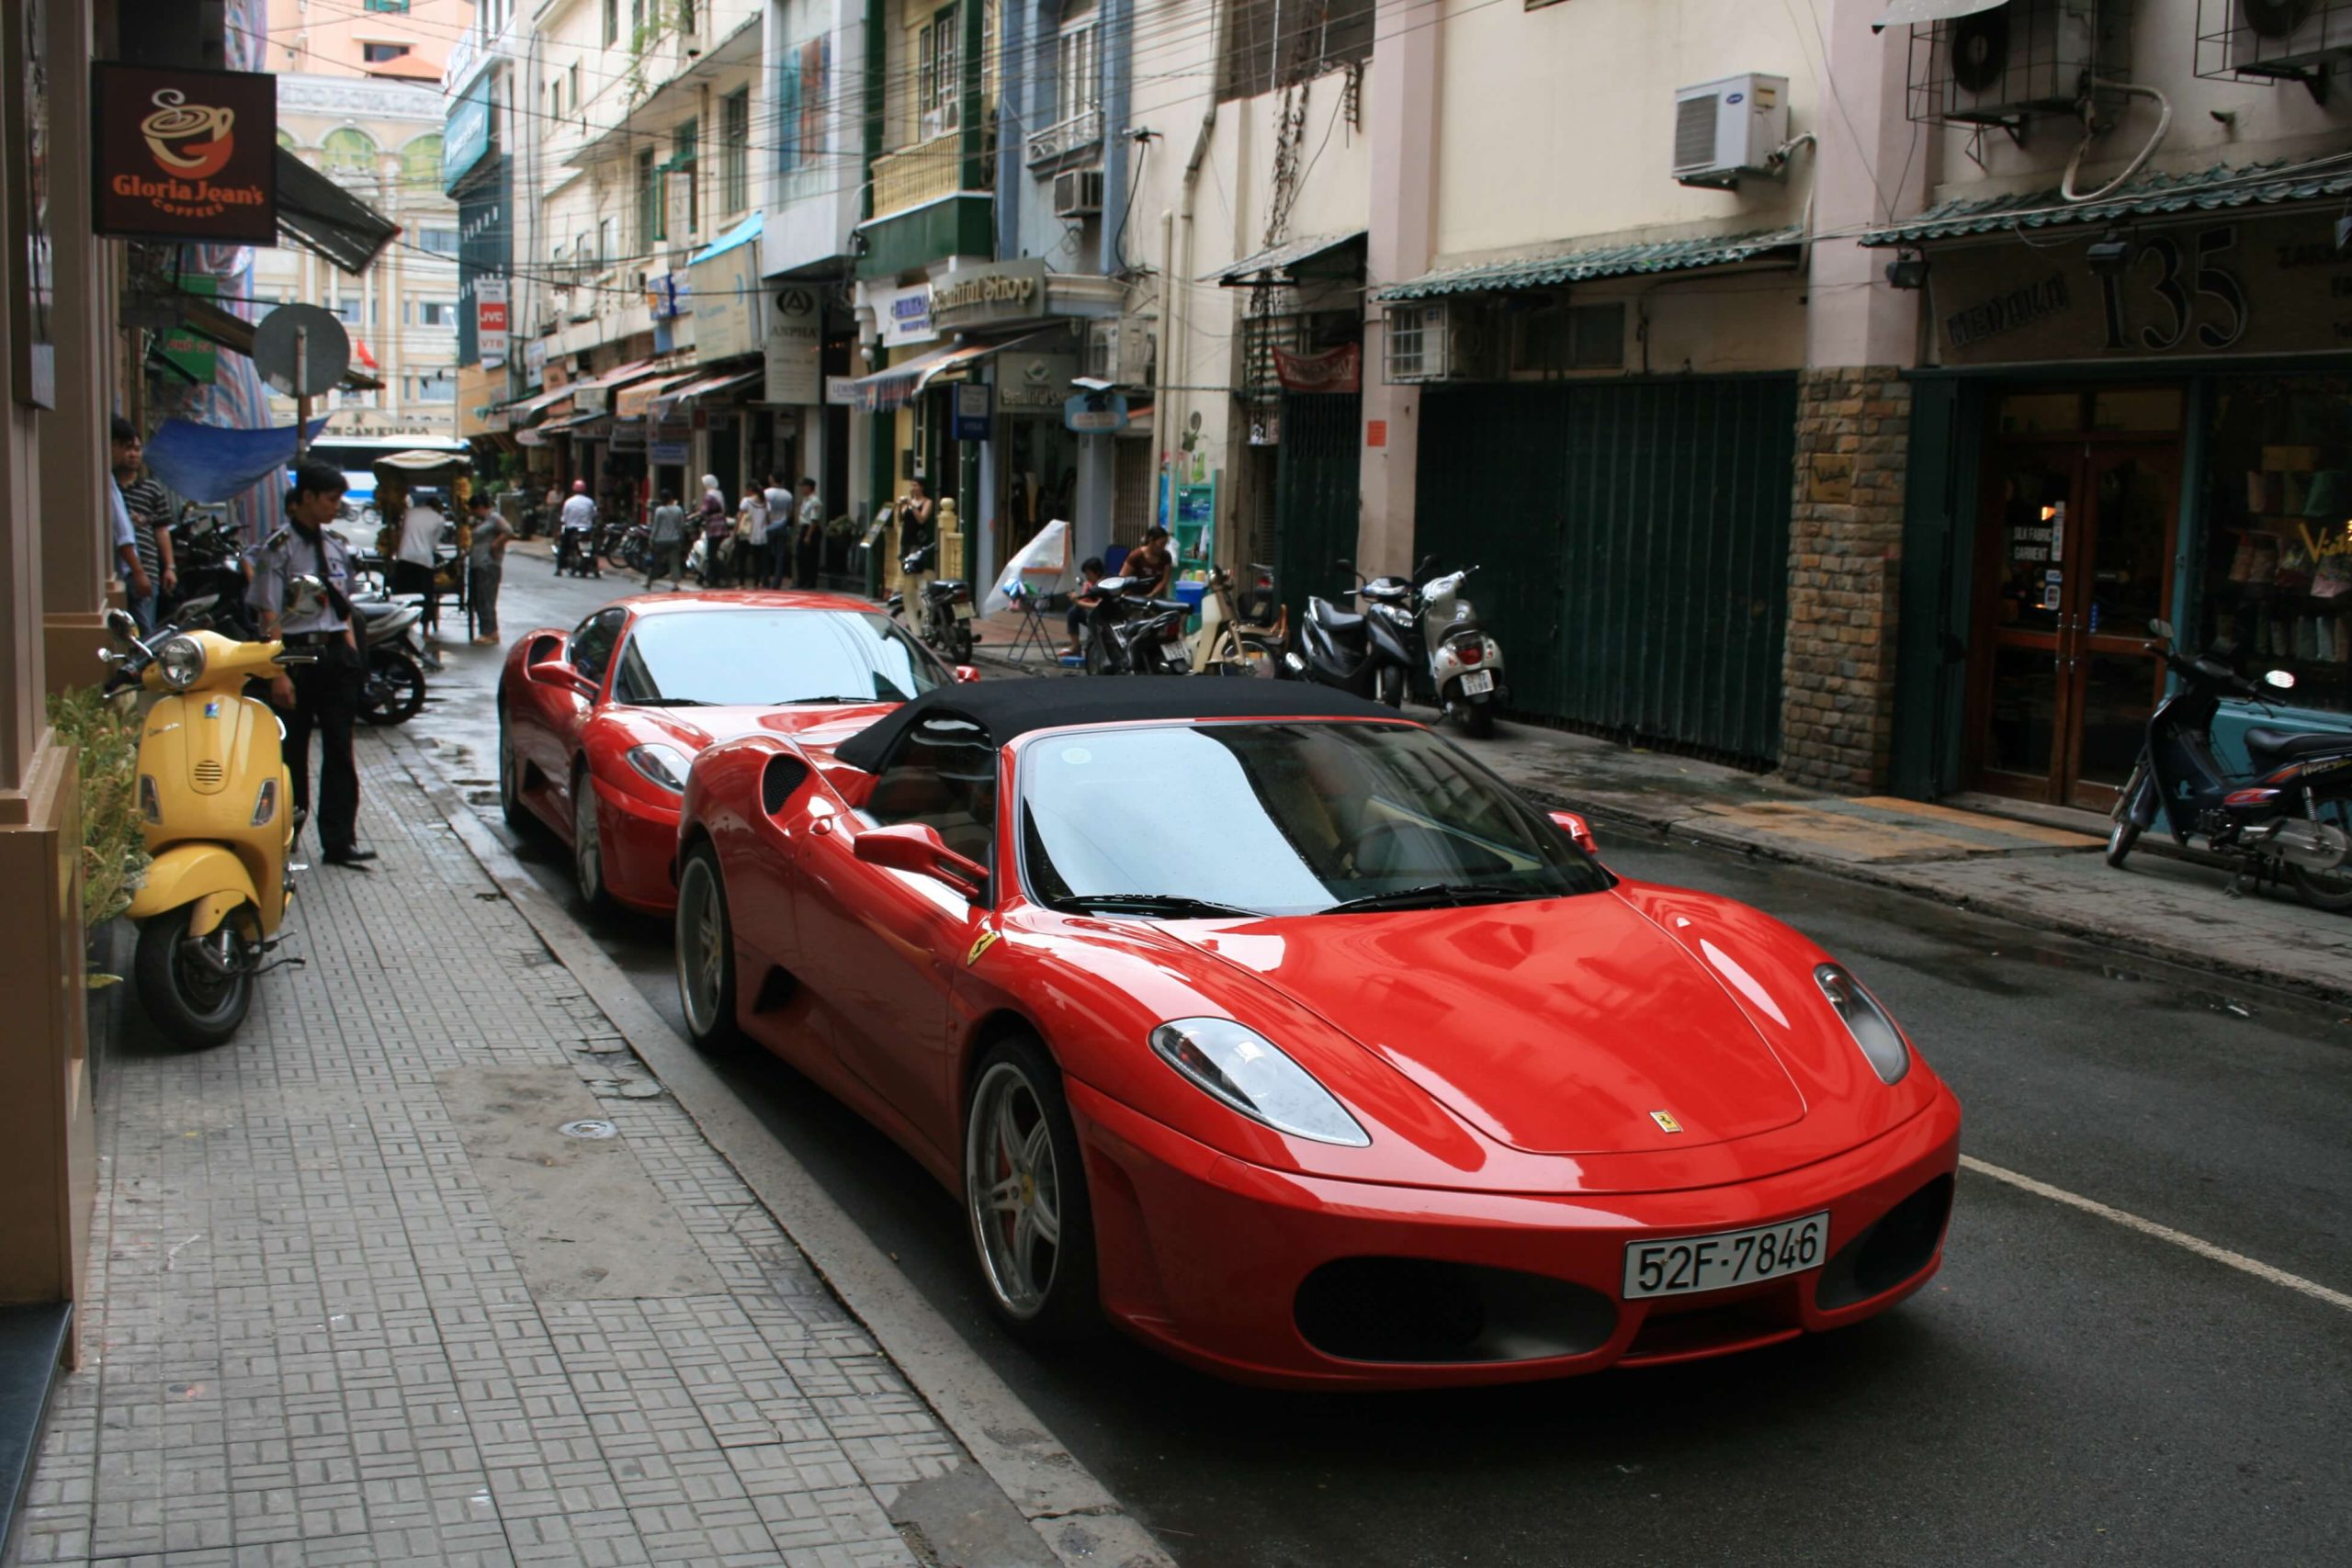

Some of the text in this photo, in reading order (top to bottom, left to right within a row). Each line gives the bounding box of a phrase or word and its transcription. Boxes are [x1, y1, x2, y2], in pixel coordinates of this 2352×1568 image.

[112, 174, 265, 206] Gloria Jean's
[152, 197, 225, 218] COFFEES
[983, 272, 1035, 306] Shop
[2101, 224, 2249, 351] 135
[481, 310, 504, 322] JVC
[1638, 1222, 1818, 1292] 52F-7846
